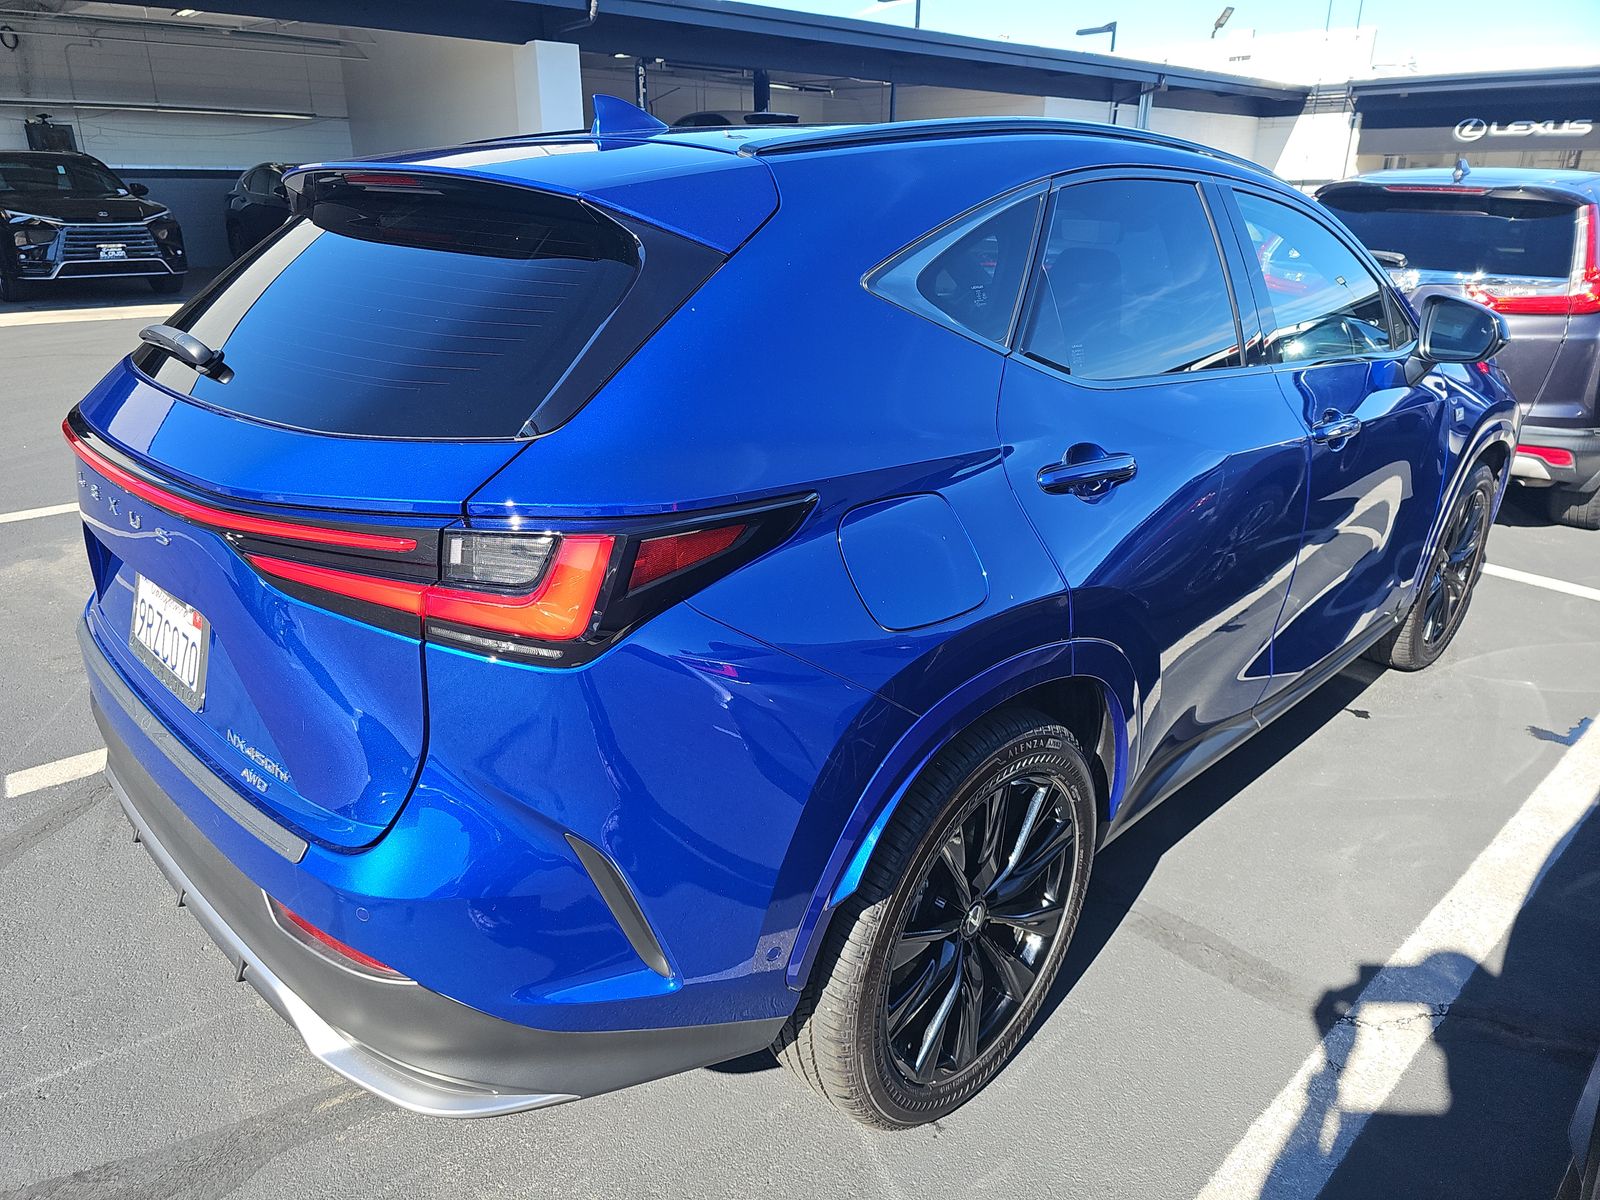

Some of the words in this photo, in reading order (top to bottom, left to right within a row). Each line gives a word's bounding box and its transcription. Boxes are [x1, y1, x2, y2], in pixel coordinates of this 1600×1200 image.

[1488, 119, 1593, 137] LEXUS
[78, 471, 172, 546] LEXUS
[1008, 739, 1044, 759] ALENZA
